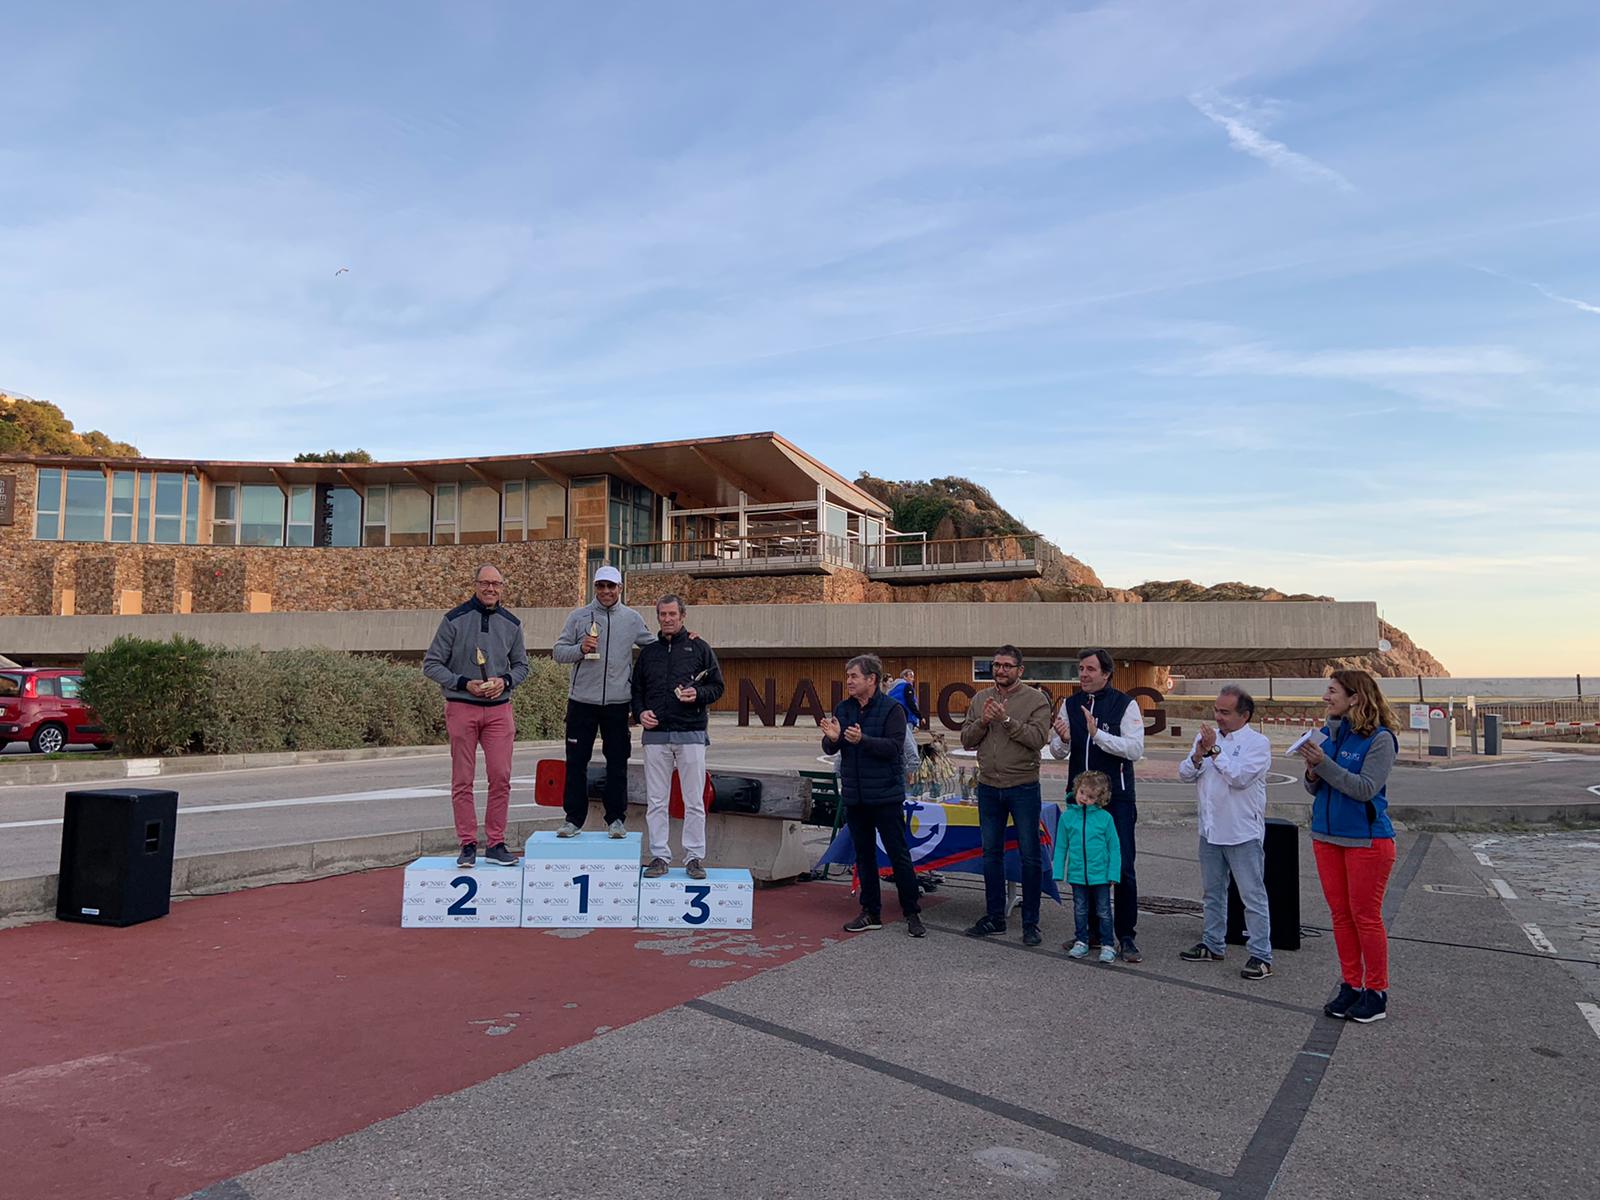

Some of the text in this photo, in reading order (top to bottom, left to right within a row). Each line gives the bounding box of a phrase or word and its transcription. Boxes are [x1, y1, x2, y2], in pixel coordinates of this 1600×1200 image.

[447, 876, 478, 915] 2
[572, 874, 589, 913] 1
[682, 885, 711, 925] 3
